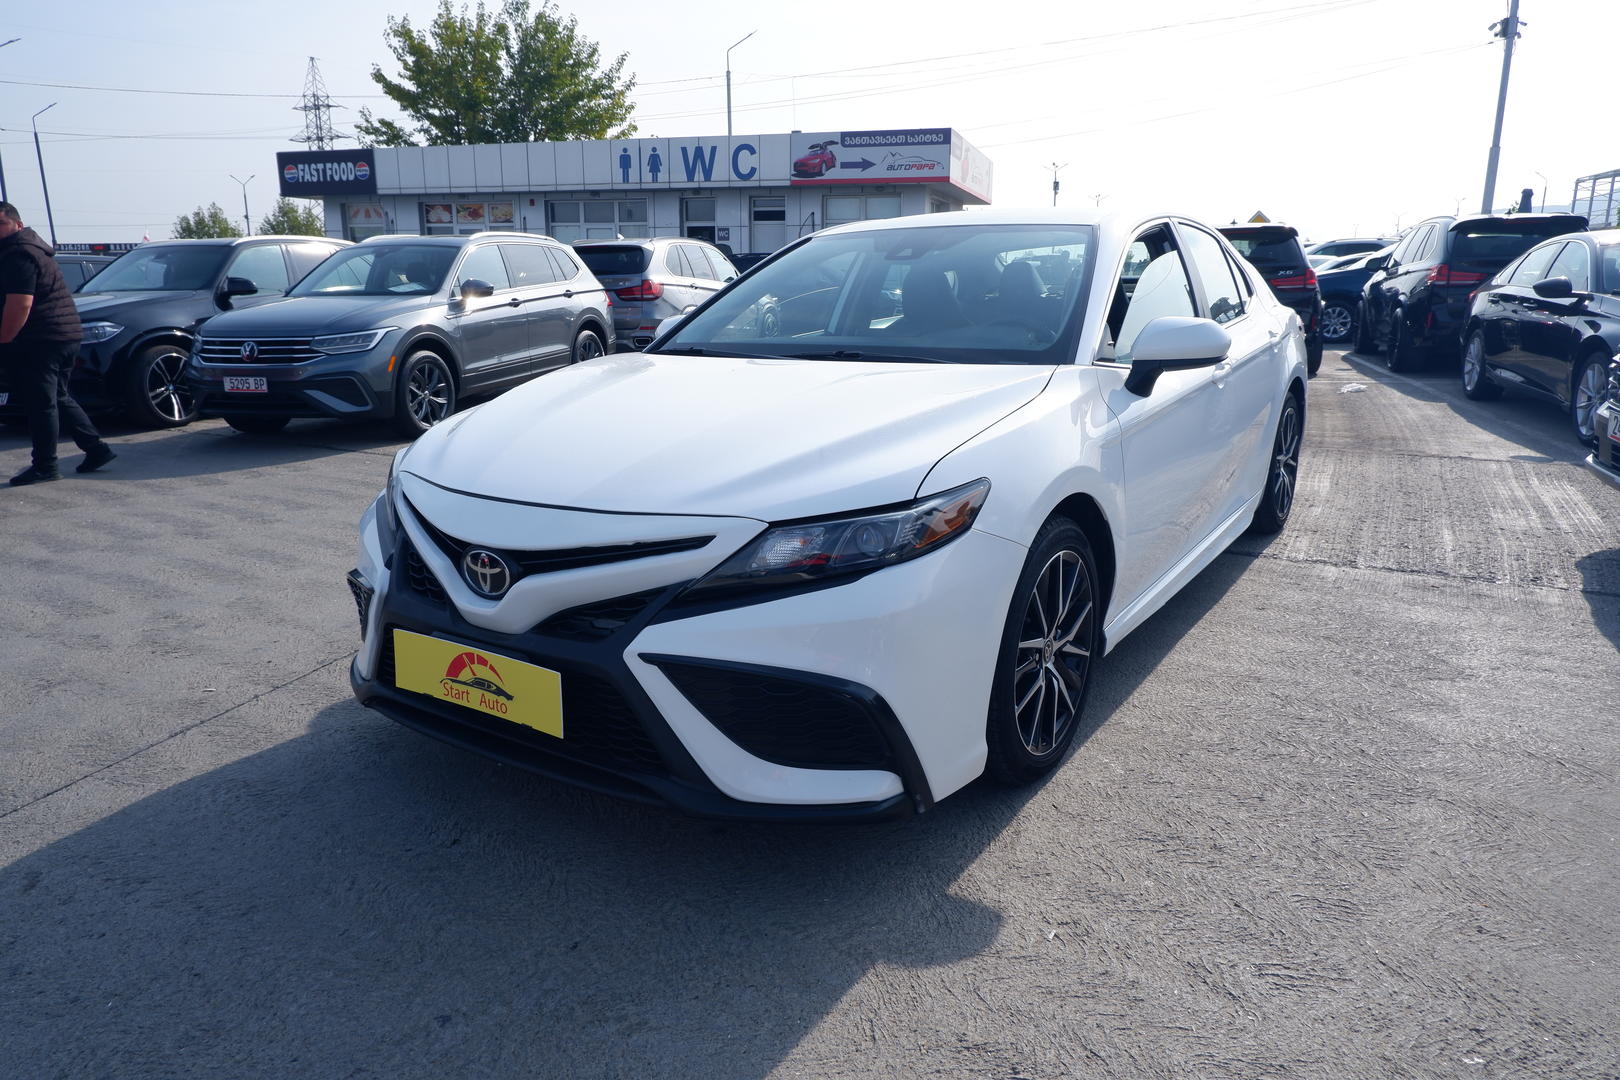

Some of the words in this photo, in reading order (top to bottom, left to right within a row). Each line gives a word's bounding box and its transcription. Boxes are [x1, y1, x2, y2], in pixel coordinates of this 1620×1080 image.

[907, 133, 944, 143] საიტზე
[298, 163, 325, 182] FAST
[325, 162, 355, 181] FOOD
[718, 230, 729, 238] WC
[230, 378, 251, 389] 5295
[443, 682, 471, 703] Start
[479, 693, 508, 714] Auto
